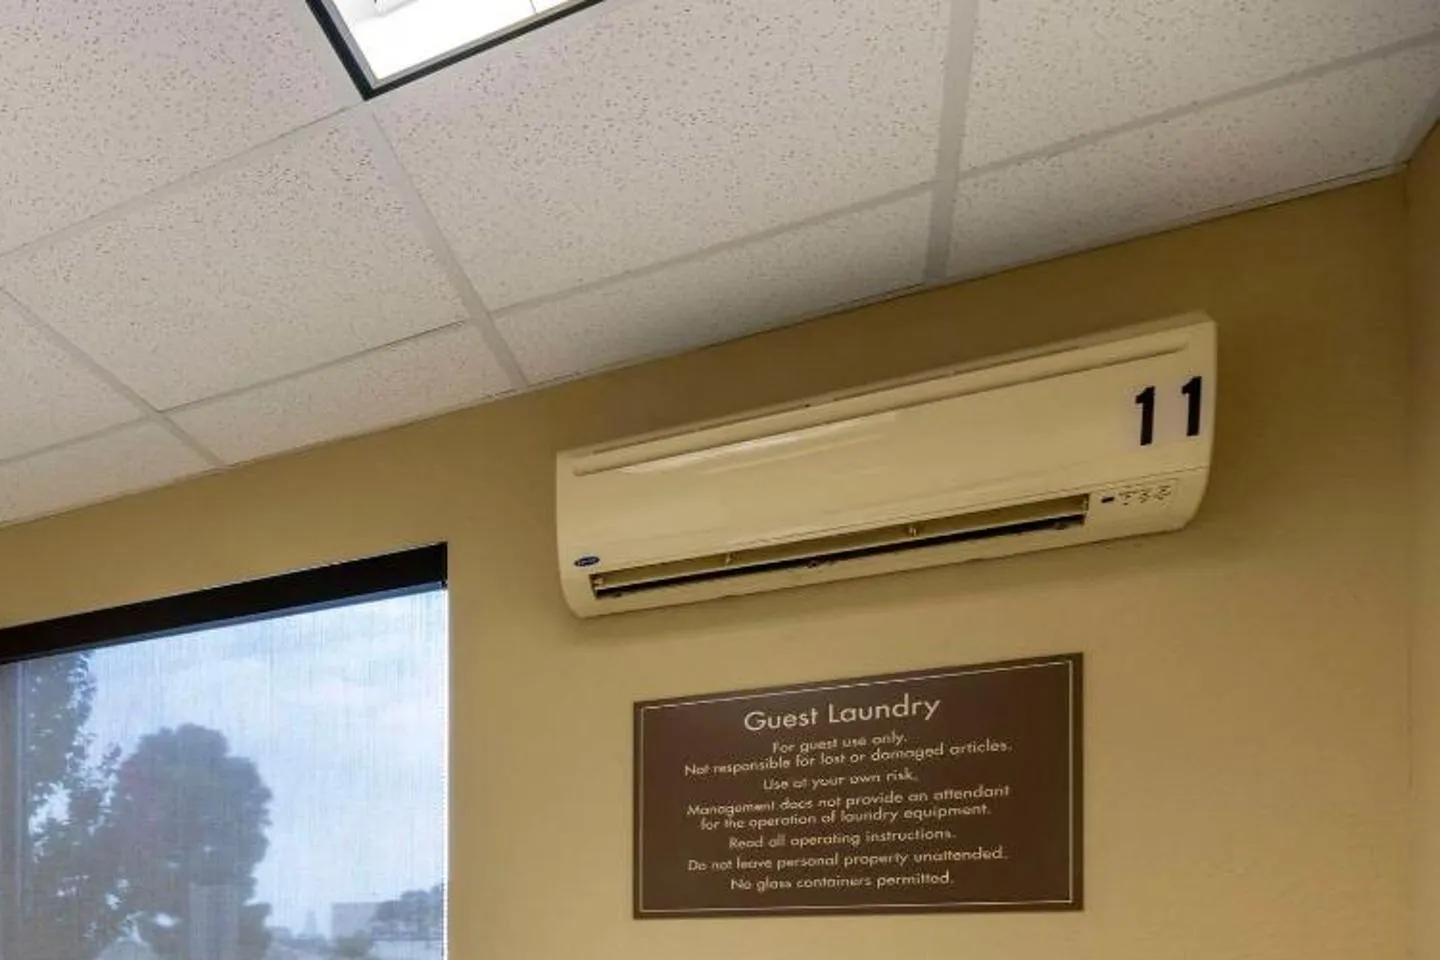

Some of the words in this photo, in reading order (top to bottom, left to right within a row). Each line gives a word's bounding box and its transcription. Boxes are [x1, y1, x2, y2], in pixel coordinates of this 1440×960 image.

[1135, 375, 1203, 446] 11
[744, 707, 819, 731] Guest
[828, 692, 941, 723] Laundry
[772, 741, 796, 753] For
[799, 738, 838, 753] guest
[842, 737, 867, 747] use
[872, 729, 908, 746] only.
[684, 763, 709, 776] Not
[713, 755, 791, 776] responsible
[795, 754, 815, 767] for
[821, 752, 846, 764] lost
[850, 753, 865, 763] or
[871, 742, 944, 761] damaged
[949, 738, 1012, 756] articles.
[763, 779, 789, 790] Use
[792, 777, 807, 788] at
[812, 776, 846, 790] your
[850, 774, 880, 785] own
[886, 767, 918, 782] risk.
[687, 801, 775, 817] Management
[779, 797, 813, 810] does
[818, 797, 841, 808] not
[845, 790, 904, 809] provide
[908, 792, 928, 801] an
[933, 785, 1010, 801] attendant
[700, 817, 720, 830] for
[724, 817, 745, 829] the
[748, 813, 817, 830] operation
[821, 810, 836, 824] of
[840, 806, 899, 823] laundry
[903, 803, 992, 821] equipment.
[729, 836, 764, 848] Read
[768, 833, 787, 847] all
[790, 833, 860, 848] operating
[866, 828, 956, 842] instructions.
[688, 859, 707, 871] Do
[712, 860, 732, 871] not
[737, 857, 772, 869] leave
[777, 852, 838, 871] personal
[844, 852, 909, 867] property
[914, 845, 1008, 863] unattended.
[731, 878, 752, 890] No
[756, 875, 792, 892] glass
[796, 875, 872, 888] containers
[877, 868, 954, 889] permitted.
